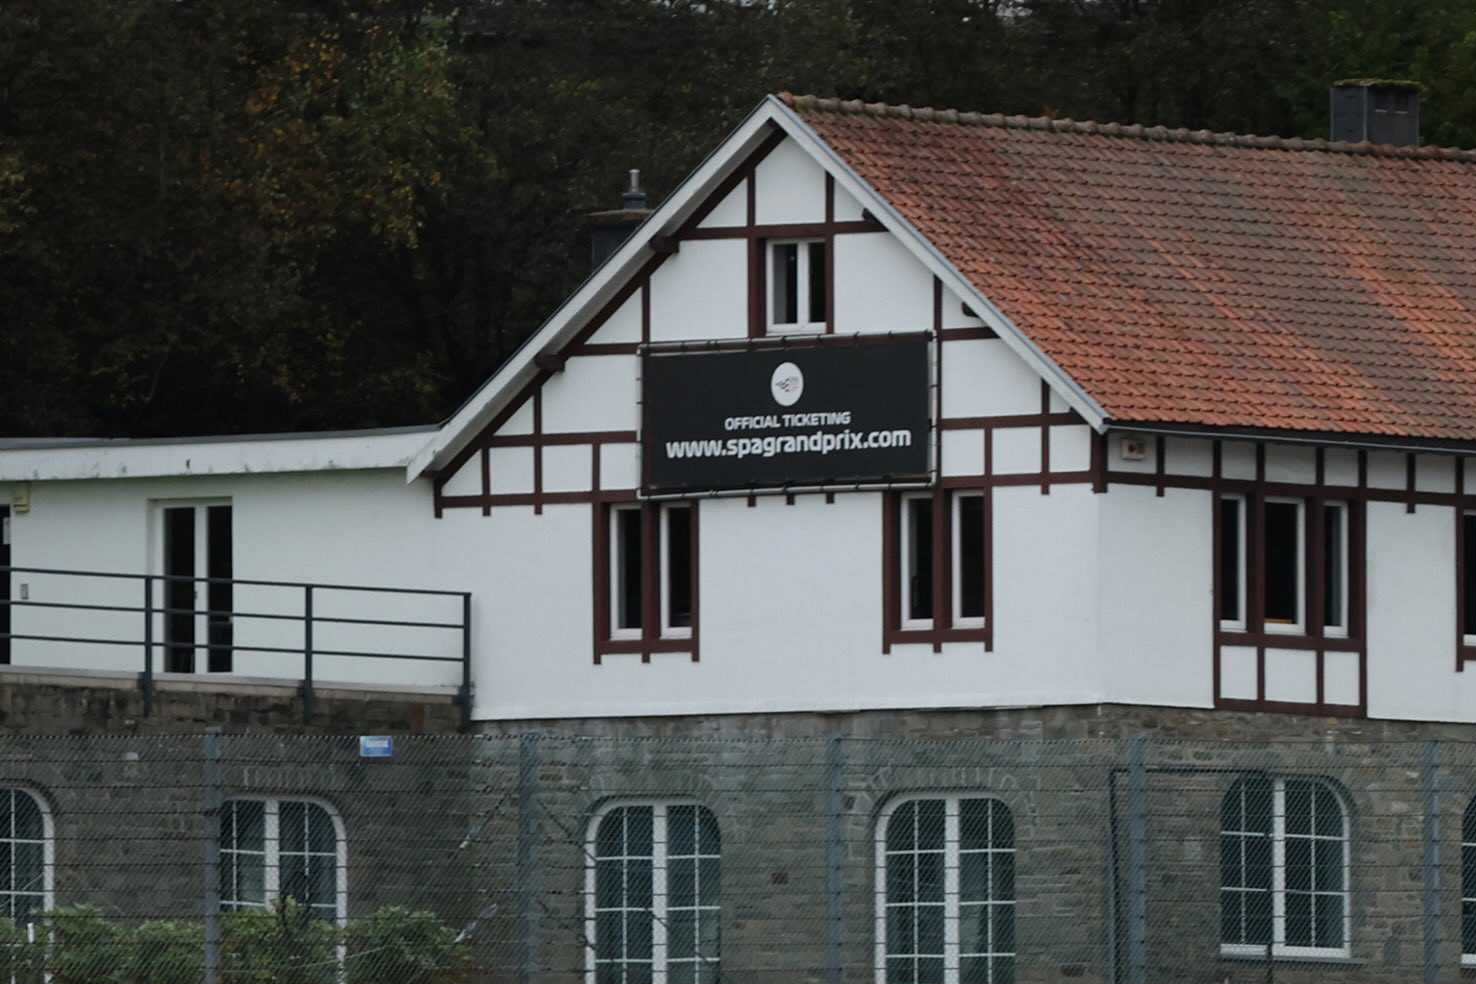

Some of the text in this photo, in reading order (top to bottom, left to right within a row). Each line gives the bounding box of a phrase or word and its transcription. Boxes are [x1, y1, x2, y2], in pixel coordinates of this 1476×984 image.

[724, 411, 851, 431] OFFICIAL TICKETING
[666, 429, 912, 459] www.spagrandprix.com
